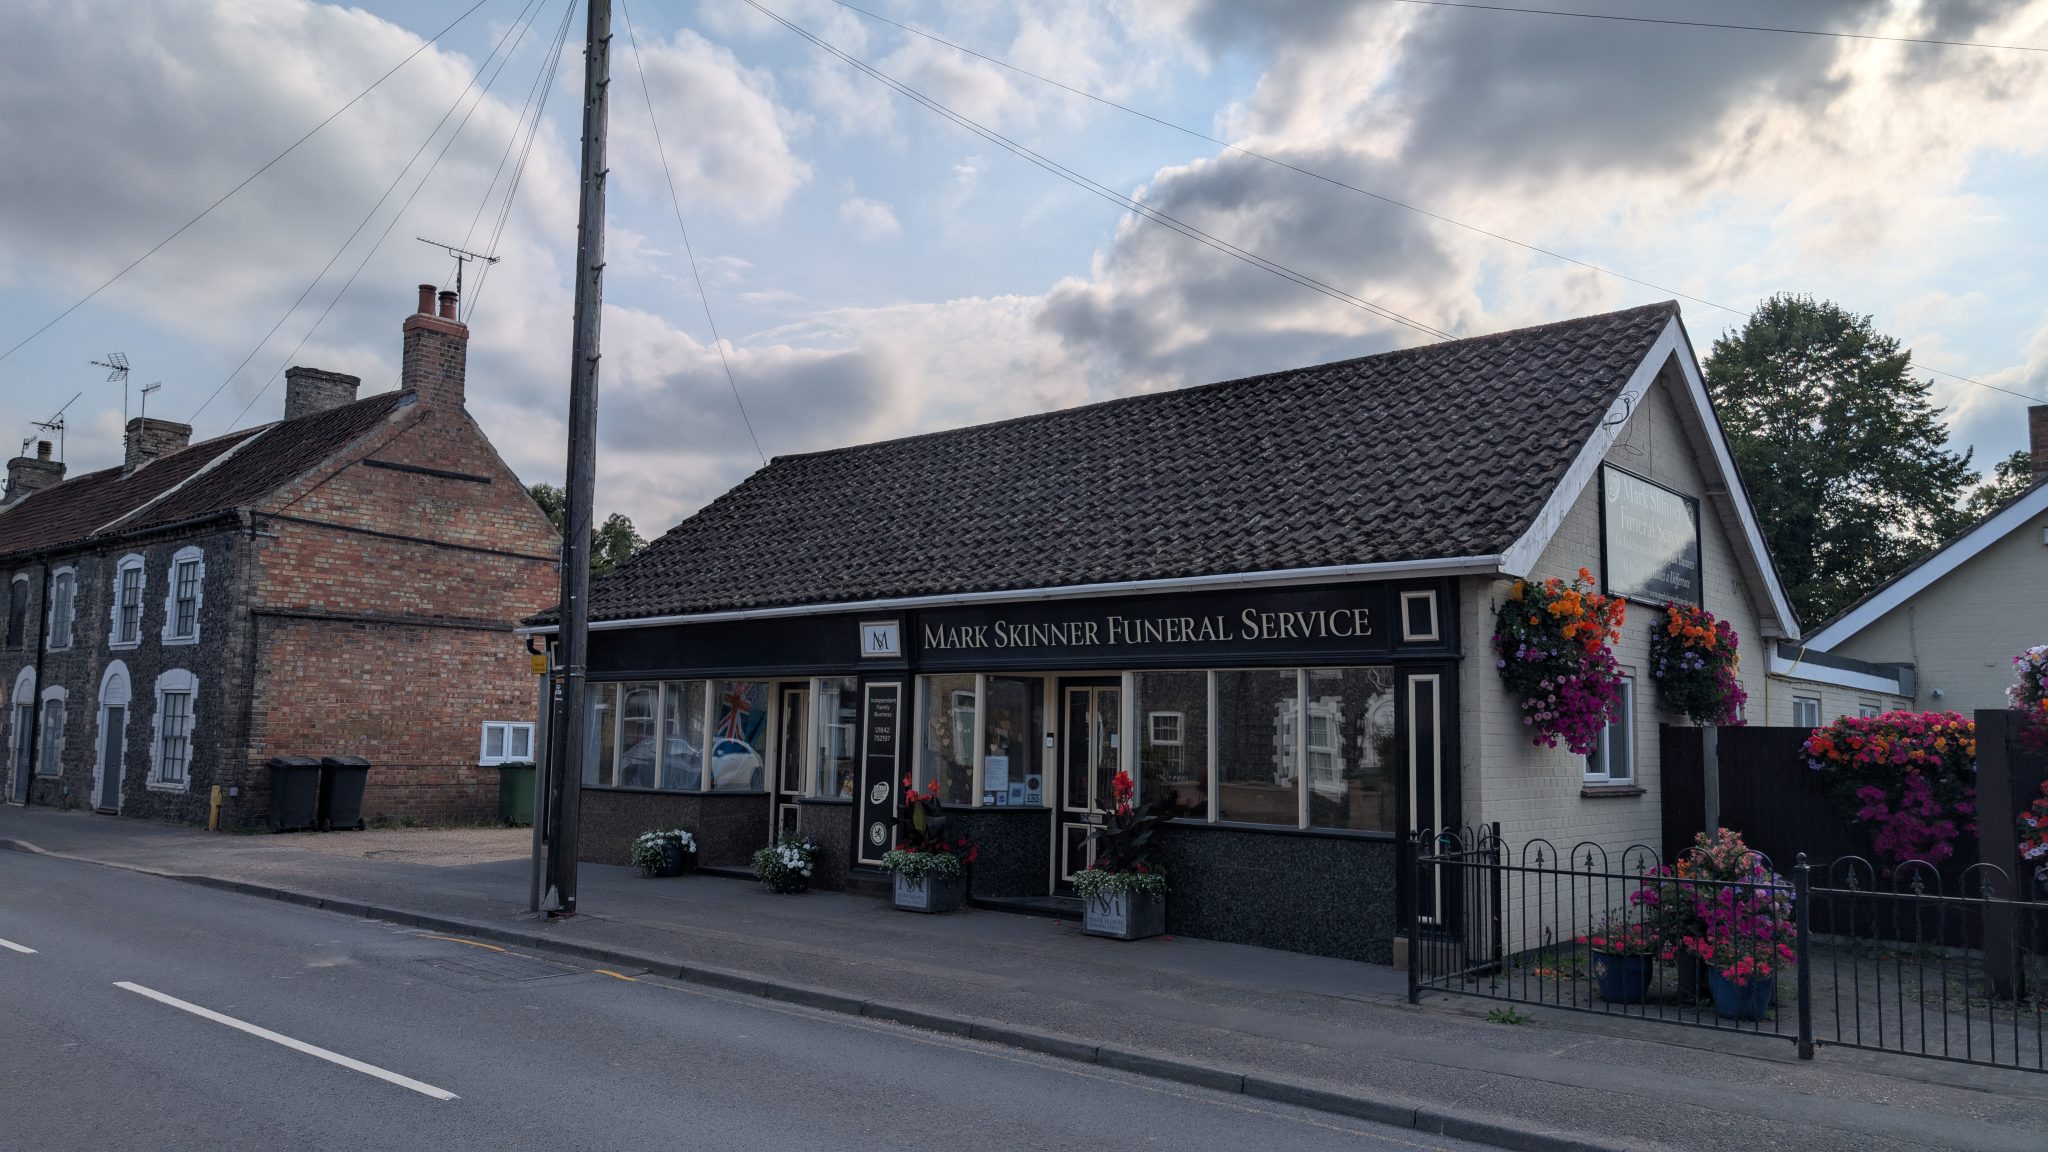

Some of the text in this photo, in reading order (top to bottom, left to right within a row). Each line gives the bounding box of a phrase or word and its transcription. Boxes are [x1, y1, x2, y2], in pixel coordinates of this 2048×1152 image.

[1623, 477, 1649, 510] Mark
[1620, 505, 1655, 538] Funeral
[924, 608, 1372, 649] MARK SKINNER FUNERAL SERVICE
